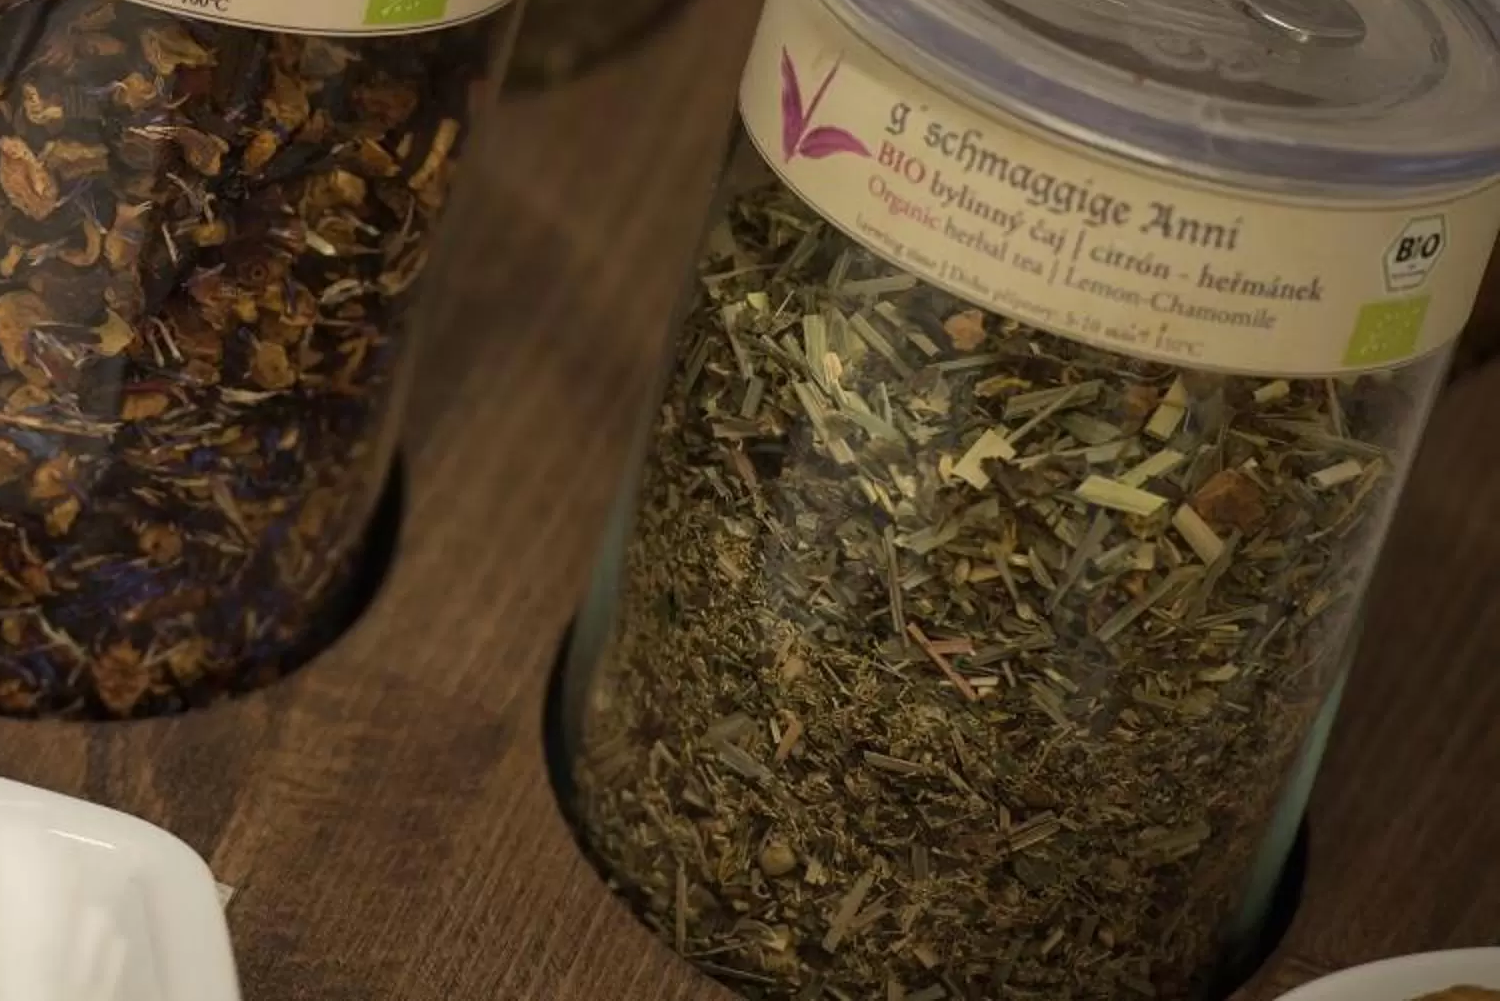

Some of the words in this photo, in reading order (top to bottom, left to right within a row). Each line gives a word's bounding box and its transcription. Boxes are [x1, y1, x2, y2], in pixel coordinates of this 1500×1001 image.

[868, 174, 941, 231] Organic
[943, 215, 1009, 262] herbal
[1012, 252, 1044, 276] tea
[876, 140, 925, 184] BIO
[930, 170, 1025, 235] bylinný
[1029, 219, 1067, 255] čaj
[1089, 244, 1170, 280] citrón
[1138, 201, 1244, 251] Anni
